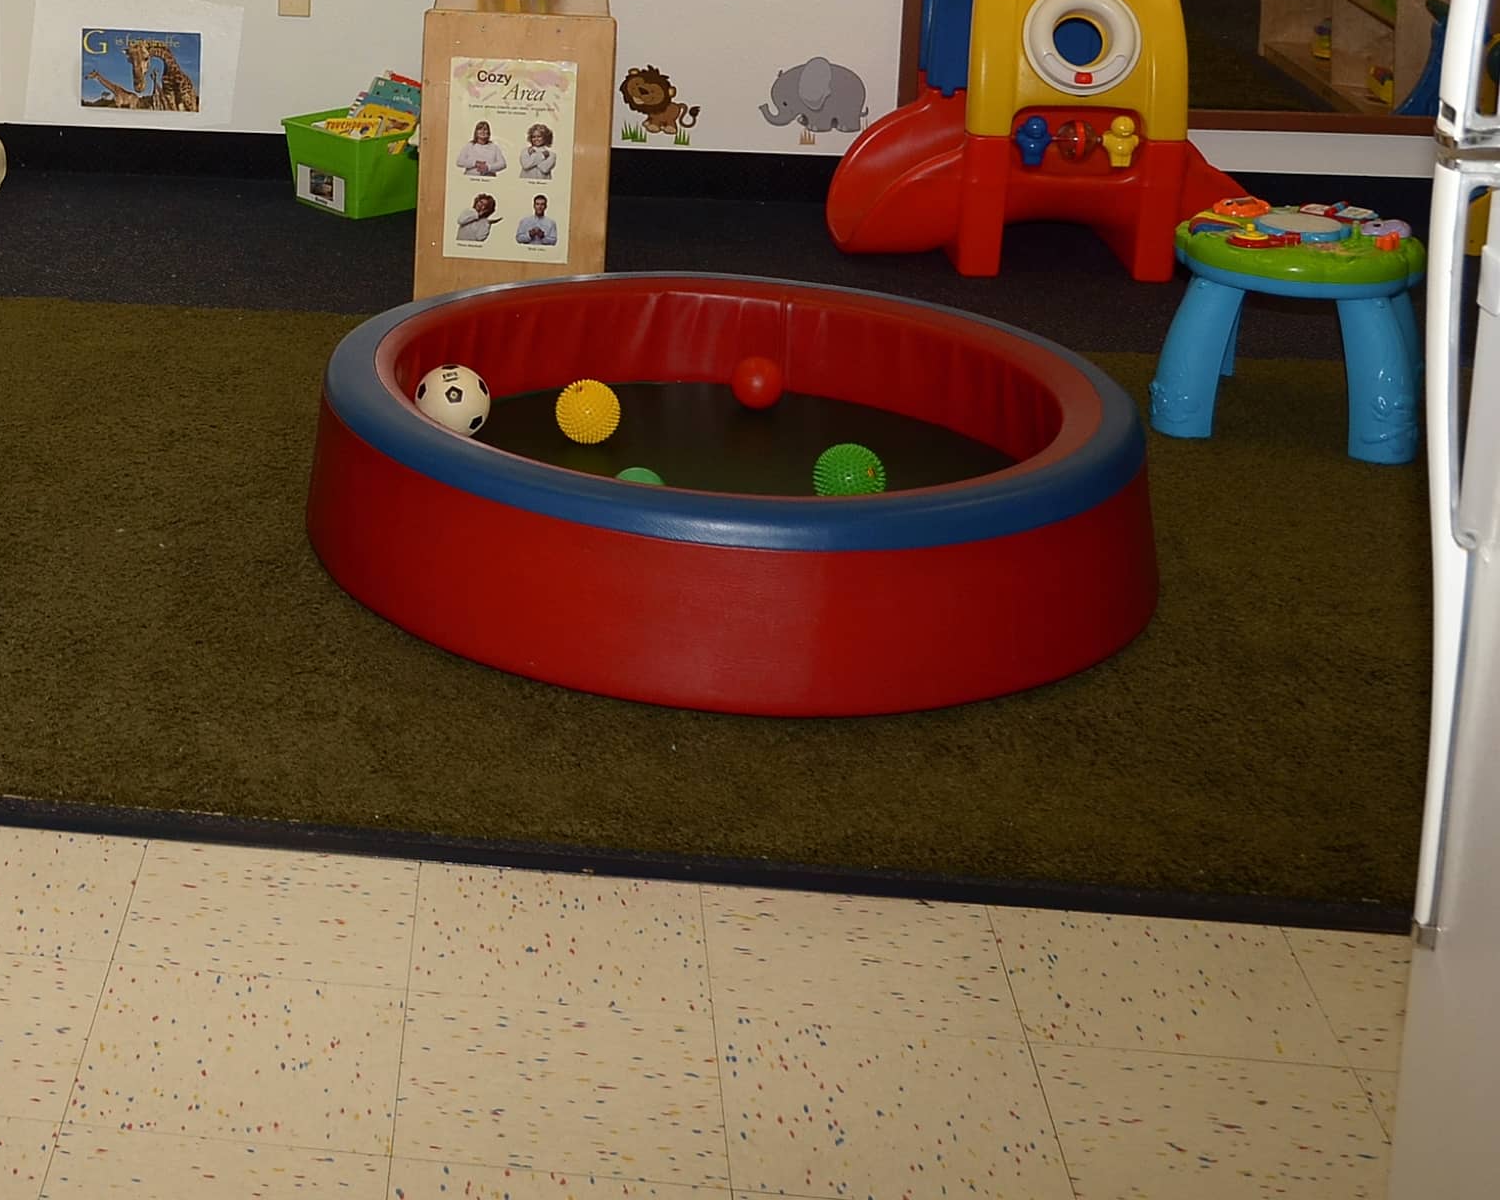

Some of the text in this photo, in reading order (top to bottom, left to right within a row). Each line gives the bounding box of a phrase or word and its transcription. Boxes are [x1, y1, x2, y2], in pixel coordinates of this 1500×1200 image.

[83, 30, 108, 55] G
[477, 70, 512, 85] Cozy
[503, 84, 546, 101] Area
